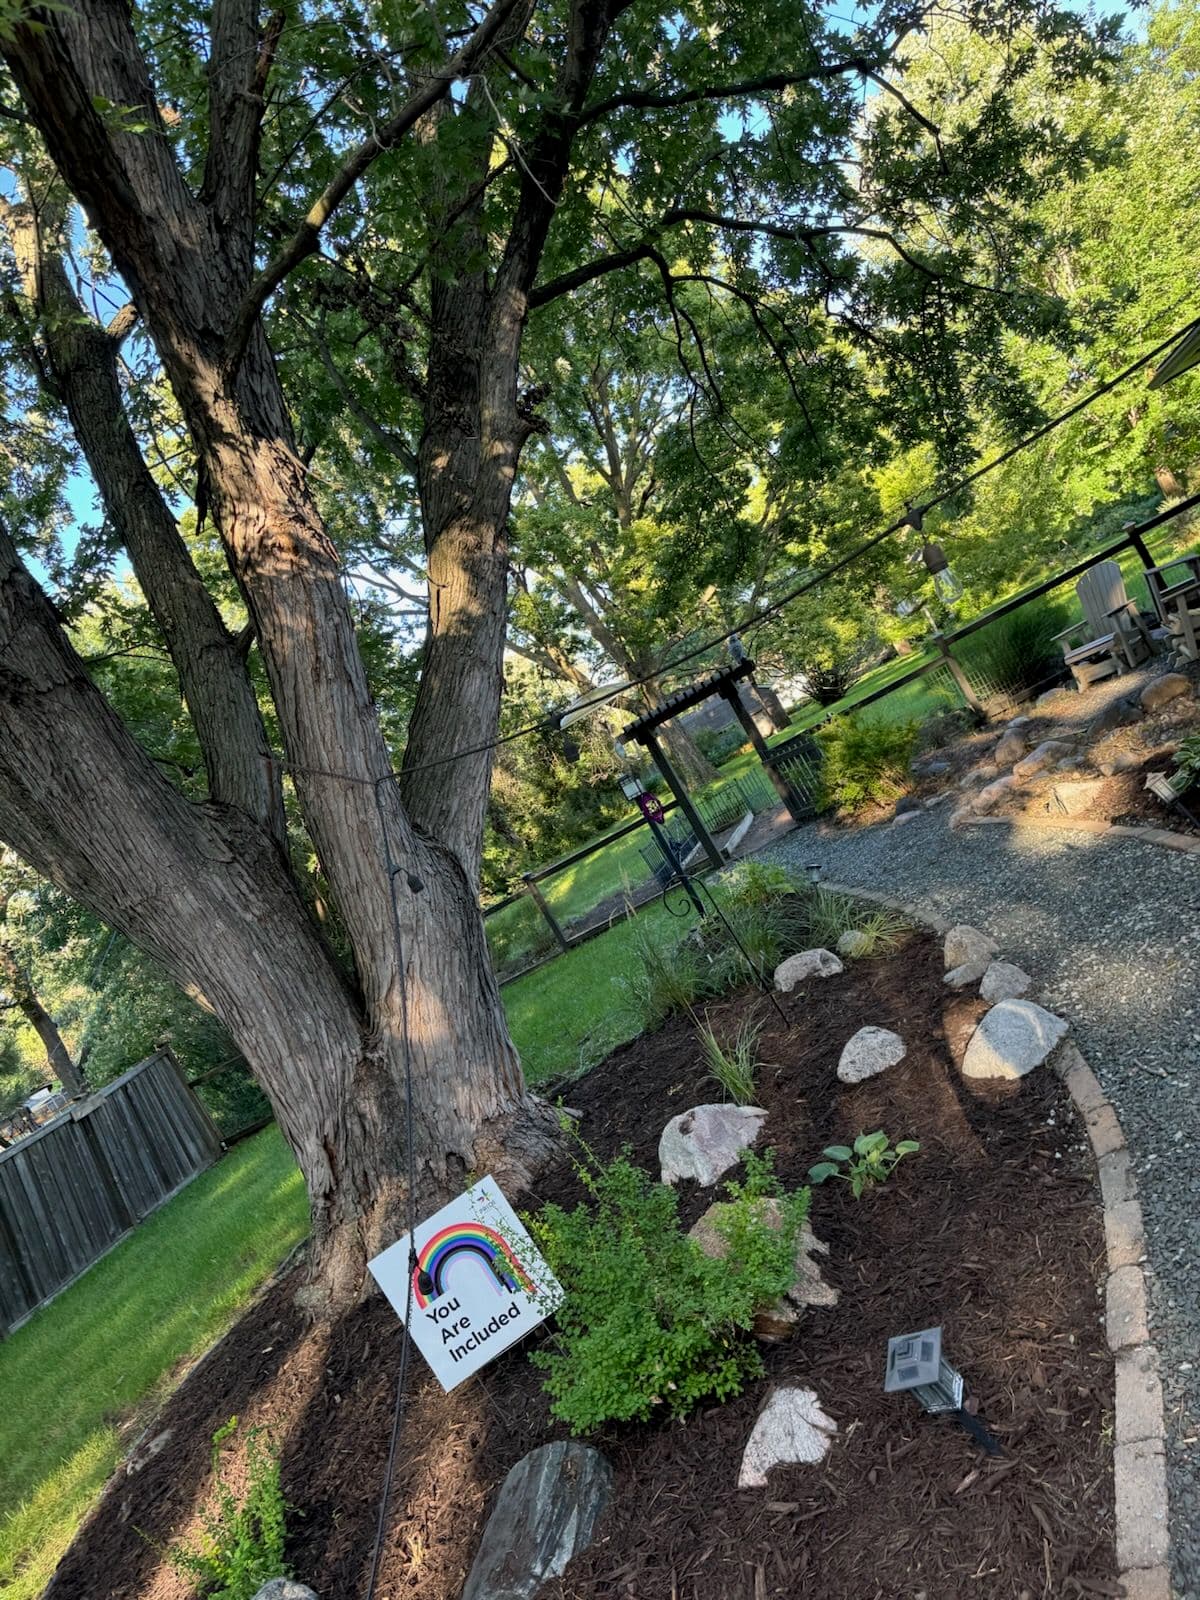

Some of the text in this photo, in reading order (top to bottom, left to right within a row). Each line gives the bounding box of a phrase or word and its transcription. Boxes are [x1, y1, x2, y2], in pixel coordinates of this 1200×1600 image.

[425, 1297, 461, 1324] You
[441, 1316, 471, 1345] Are
[449, 1301, 521, 1363] Included
